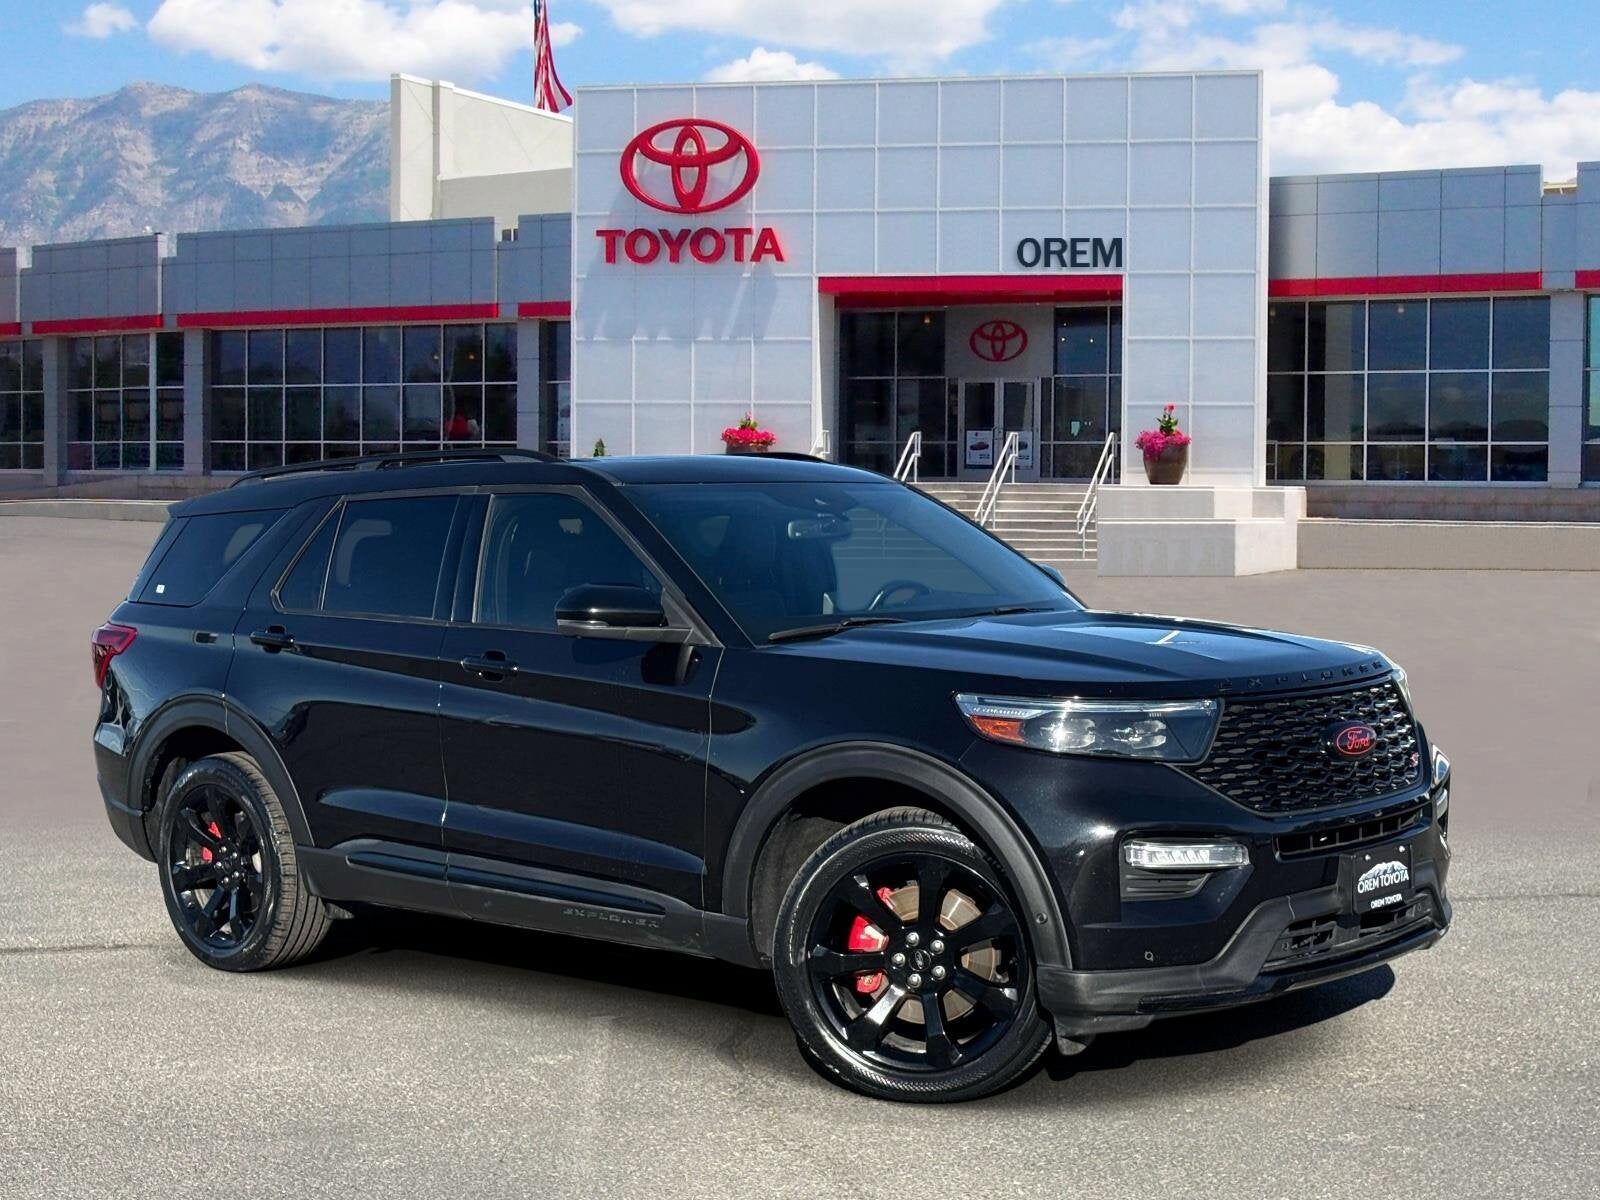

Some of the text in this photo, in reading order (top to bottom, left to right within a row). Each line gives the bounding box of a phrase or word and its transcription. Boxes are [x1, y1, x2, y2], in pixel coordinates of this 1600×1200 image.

[596, 227, 784, 264] TOYOTA
[1017, 238, 1122, 267] OREM
[1347, 730, 1370, 750] Ford
[1357, 869, 1410, 894] OREM TOYOTA
